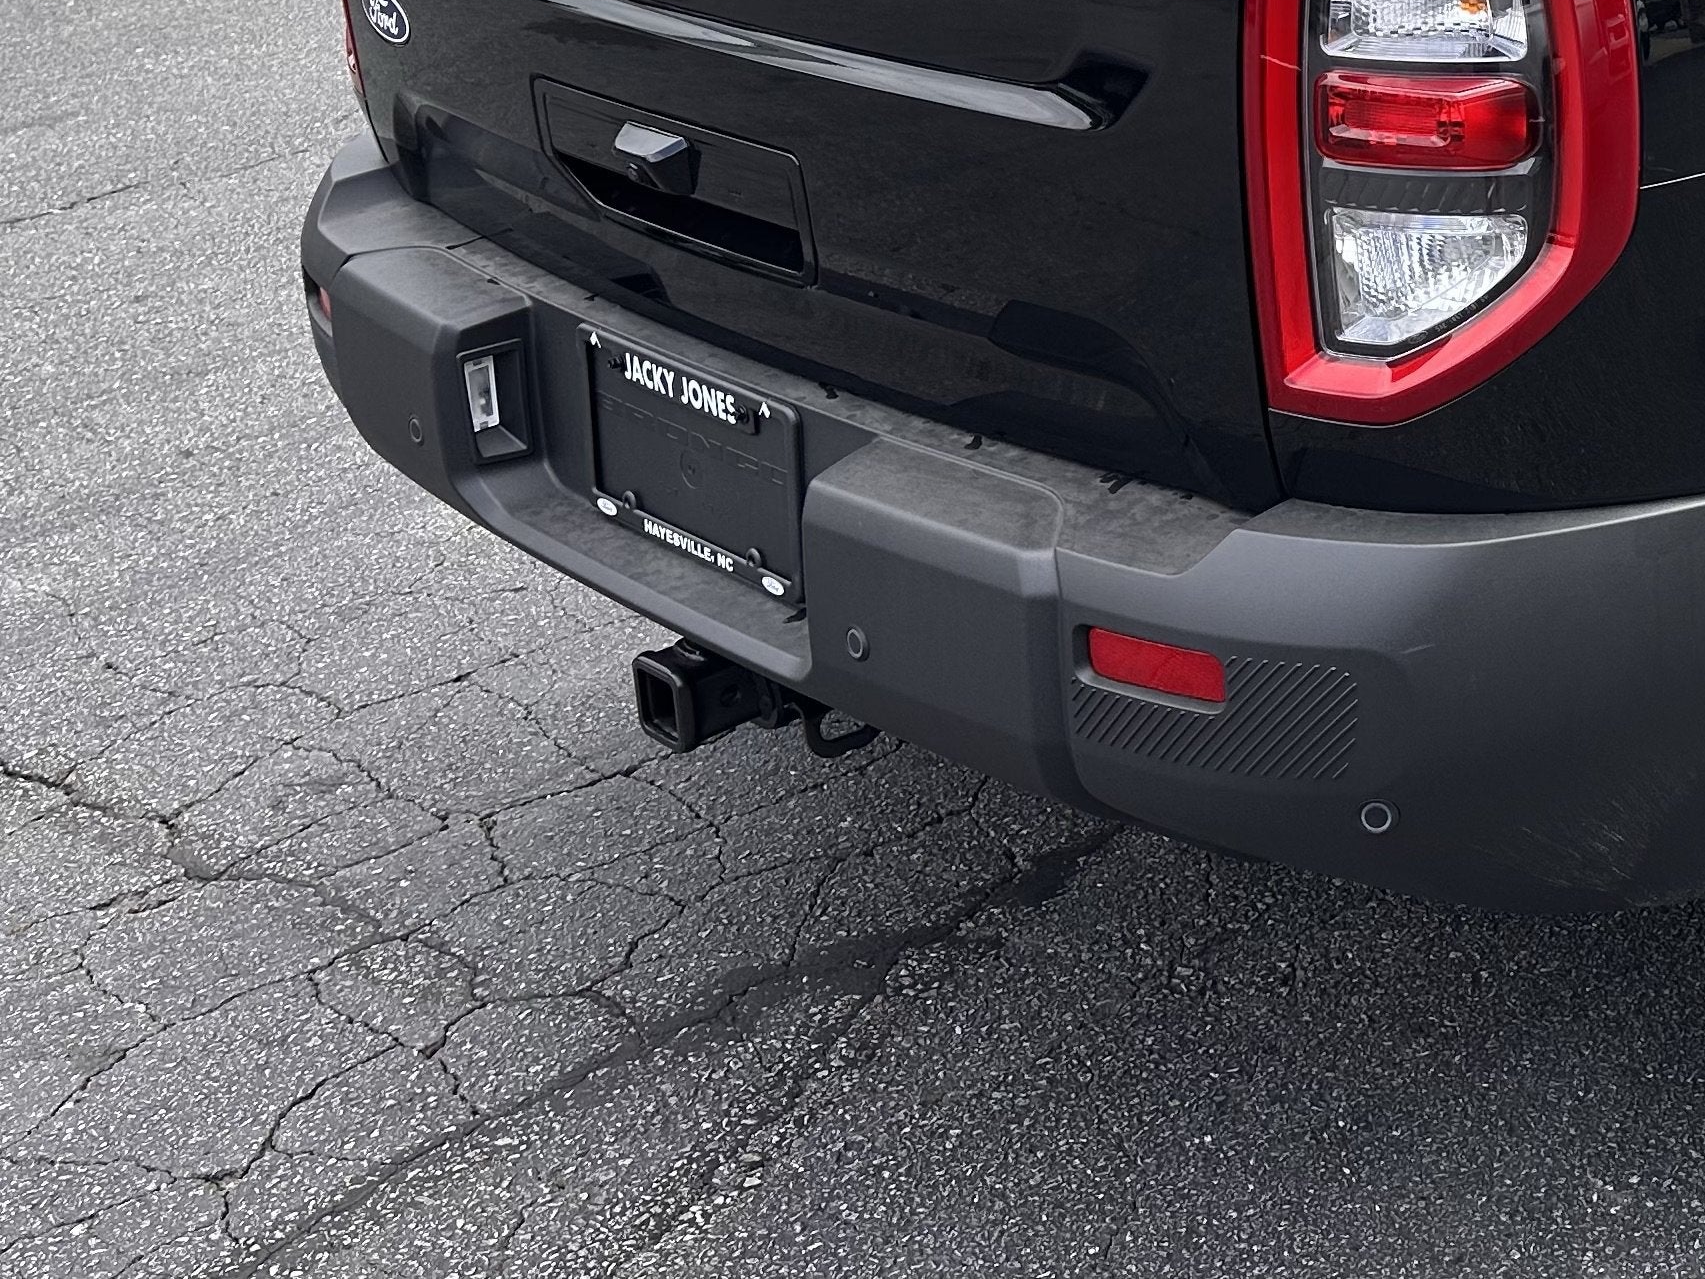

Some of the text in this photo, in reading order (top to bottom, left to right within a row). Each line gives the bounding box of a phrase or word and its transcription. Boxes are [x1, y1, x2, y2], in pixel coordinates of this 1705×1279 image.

[624, 352, 737, 425] JACKY JONES
[643, 519, 734, 572] HAYESVILLE, NC
